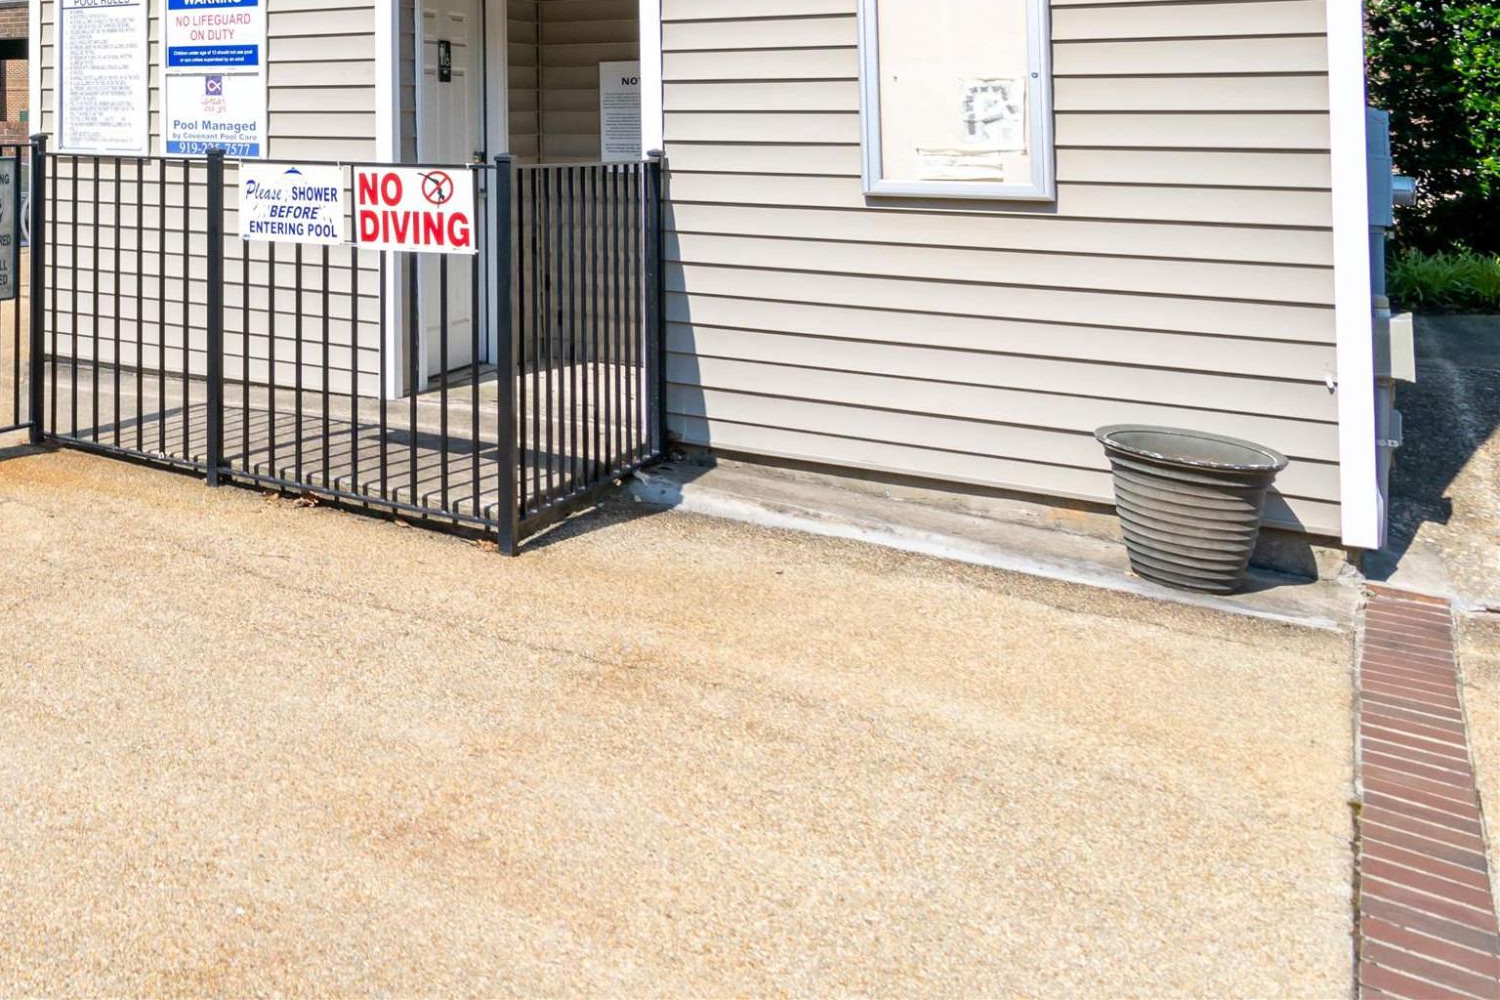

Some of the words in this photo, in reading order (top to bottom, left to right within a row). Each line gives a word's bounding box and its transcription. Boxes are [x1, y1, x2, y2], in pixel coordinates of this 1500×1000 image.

[176, 16, 190, 27] NO
[193, 13, 250, 26] LIFEGUARD
[190, 30, 204, 40] ON
[208, 29, 234, 40] DUTY
[173, 120, 198, 130] Pool
[202, 120, 256, 133] Managed
[173, 132, 181, 140] by
[183, 132, 218, 140] Covenant
[246, 179, 282, 200] Please
[292, 186, 338, 202] SHOWER
[359, 172, 403, 206] NO
[270, 205, 319, 220] BEFORE
[250, 220, 304, 236] ENTERING
[308, 224, 338, 238] POOL
[360, 209, 470, 247] DIVING
